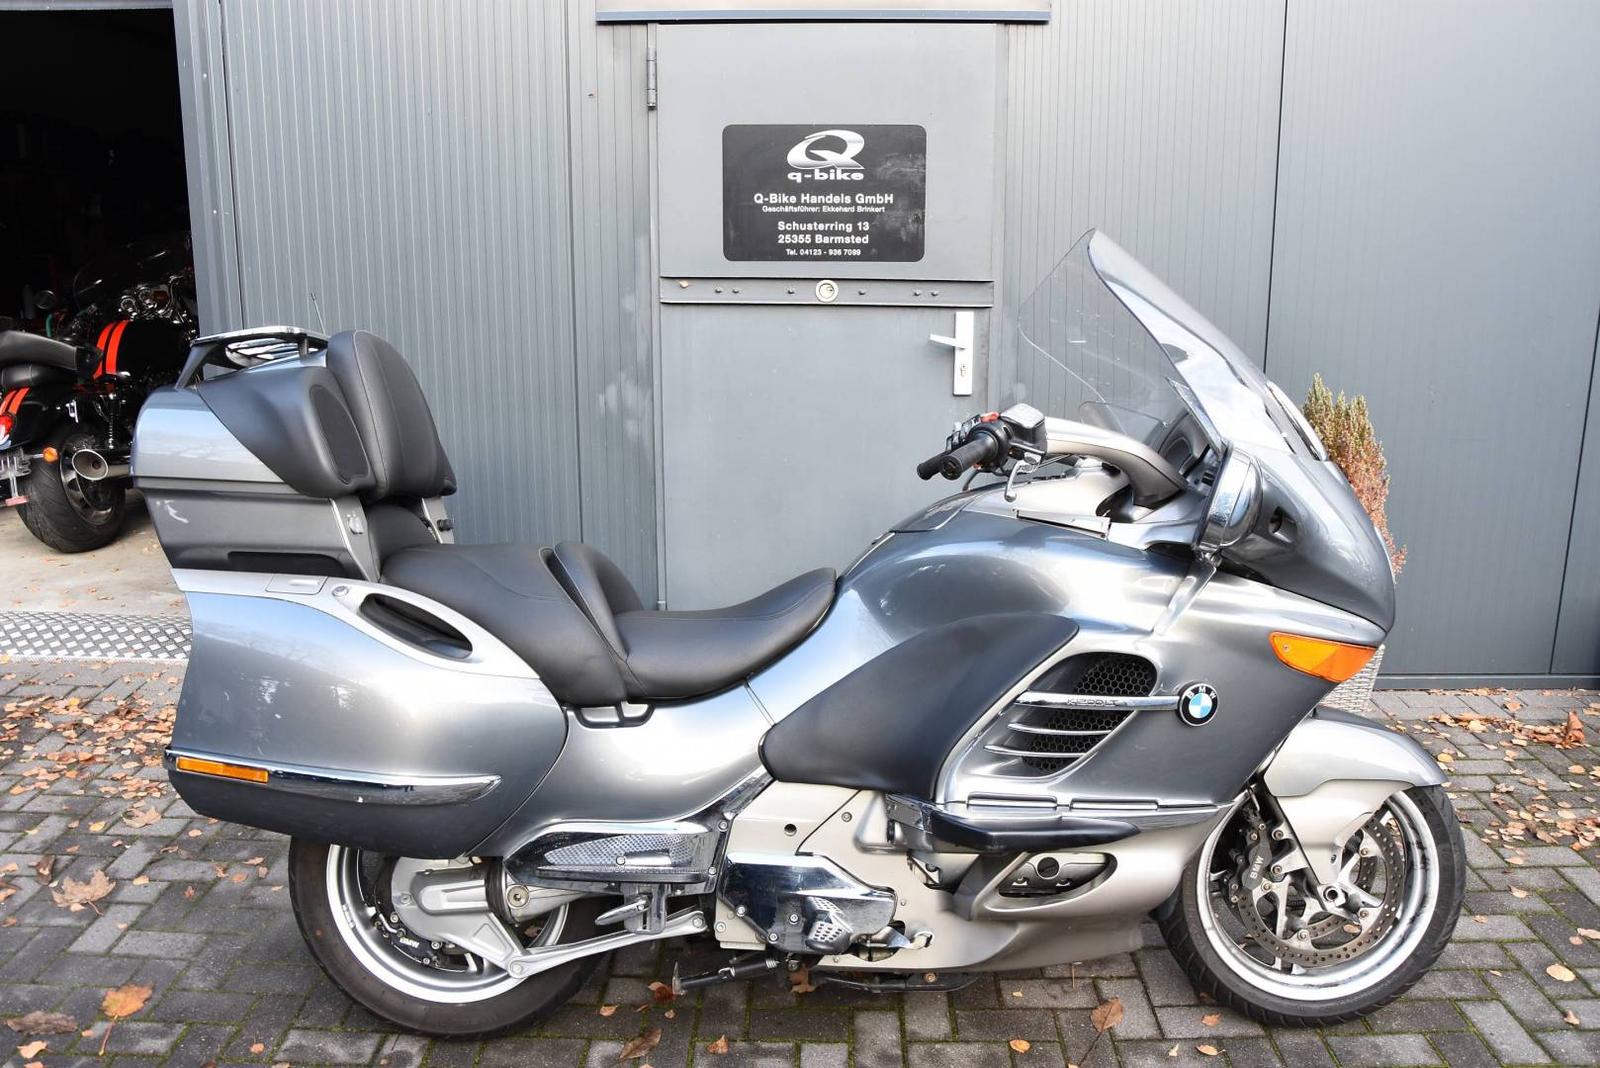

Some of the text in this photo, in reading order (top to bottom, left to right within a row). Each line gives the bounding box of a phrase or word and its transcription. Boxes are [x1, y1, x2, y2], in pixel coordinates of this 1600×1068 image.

[787, 168, 864, 183] q-bike
[754, 193, 894, 204] Q-Bike Handels GmbH
[822, 205, 855, 213] Ekkehard
[857, 205, 885, 213] Brinkert
[777, 221, 870, 232] Schusterring 13
[777, 234, 869, 244] 25355 Barmsted
[1183, 685, 1217, 699] BMW
[1250, 855, 1265, 879] BMW
